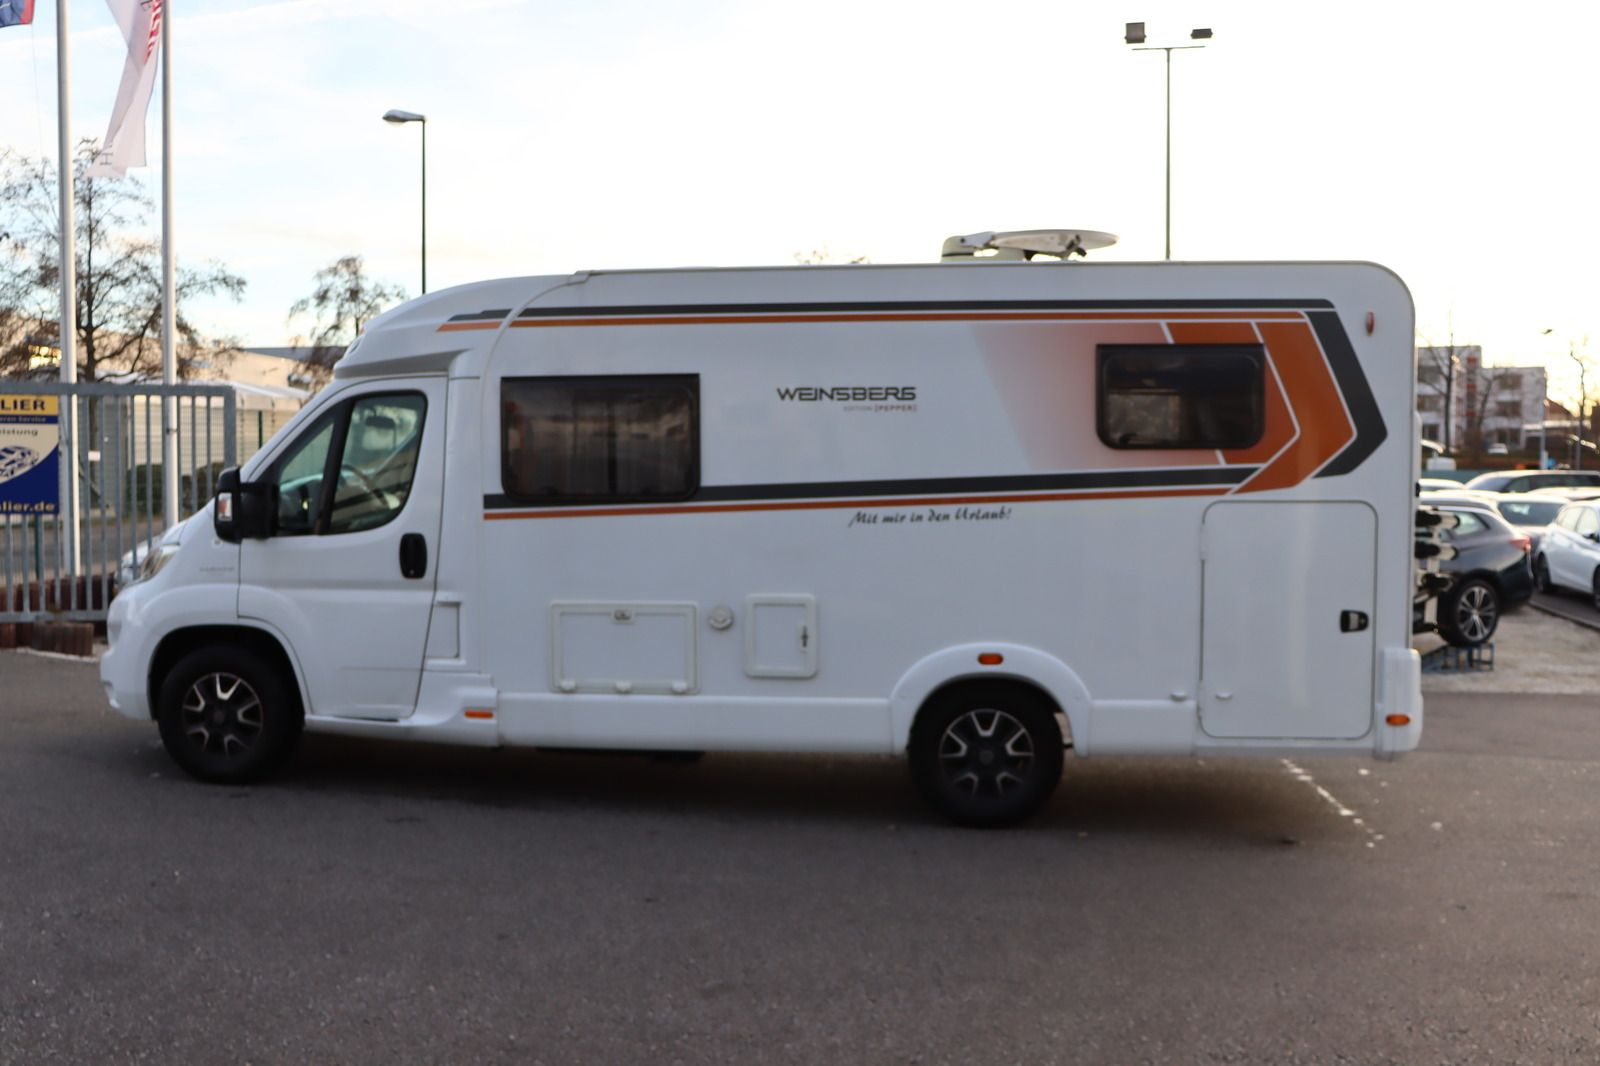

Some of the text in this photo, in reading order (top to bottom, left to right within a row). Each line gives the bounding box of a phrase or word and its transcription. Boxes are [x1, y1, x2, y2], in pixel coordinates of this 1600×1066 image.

[776, 386, 917, 401] WEINSBERG
[848, 506, 1012, 528] Mit mir in den Urlaub!
